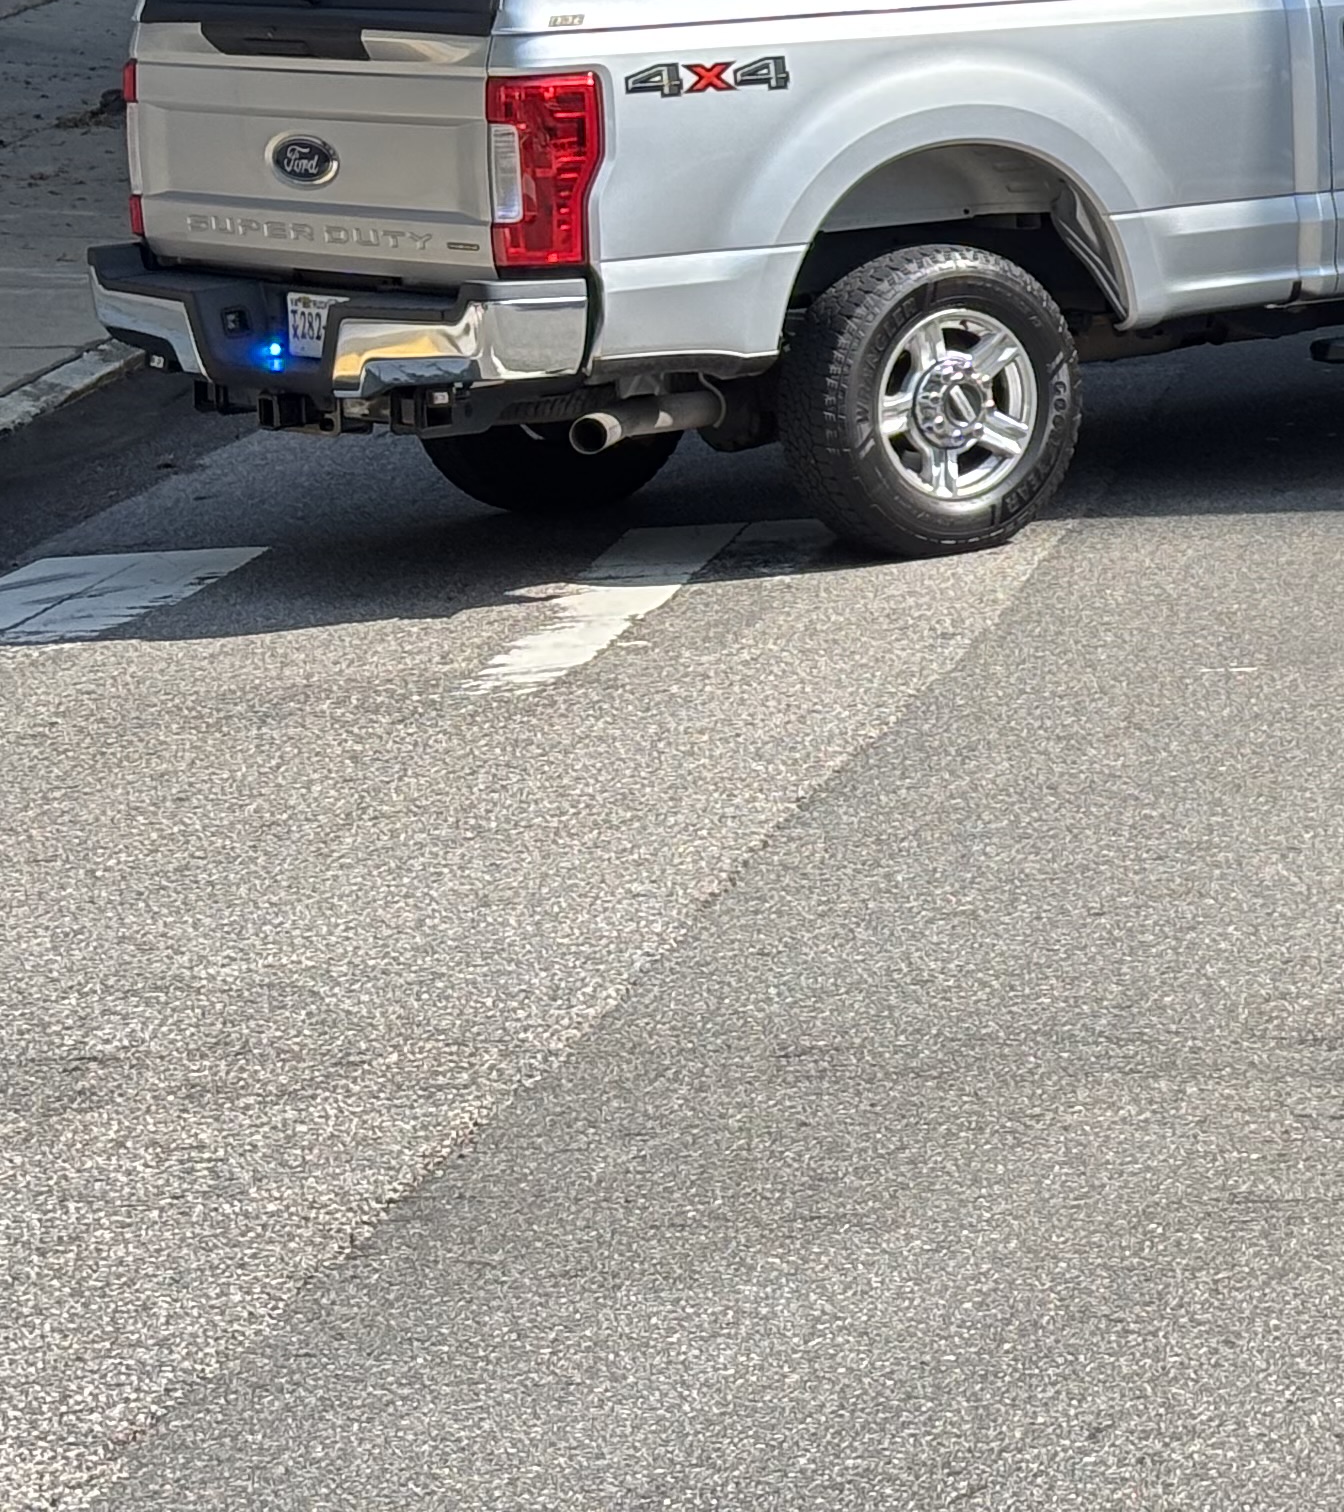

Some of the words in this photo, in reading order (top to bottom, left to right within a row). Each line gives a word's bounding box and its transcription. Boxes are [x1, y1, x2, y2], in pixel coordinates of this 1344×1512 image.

[284, 144, 320, 175] Ford
[186, 214, 314, 242] SUPER
[323, 224, 433, 251] DUTY
